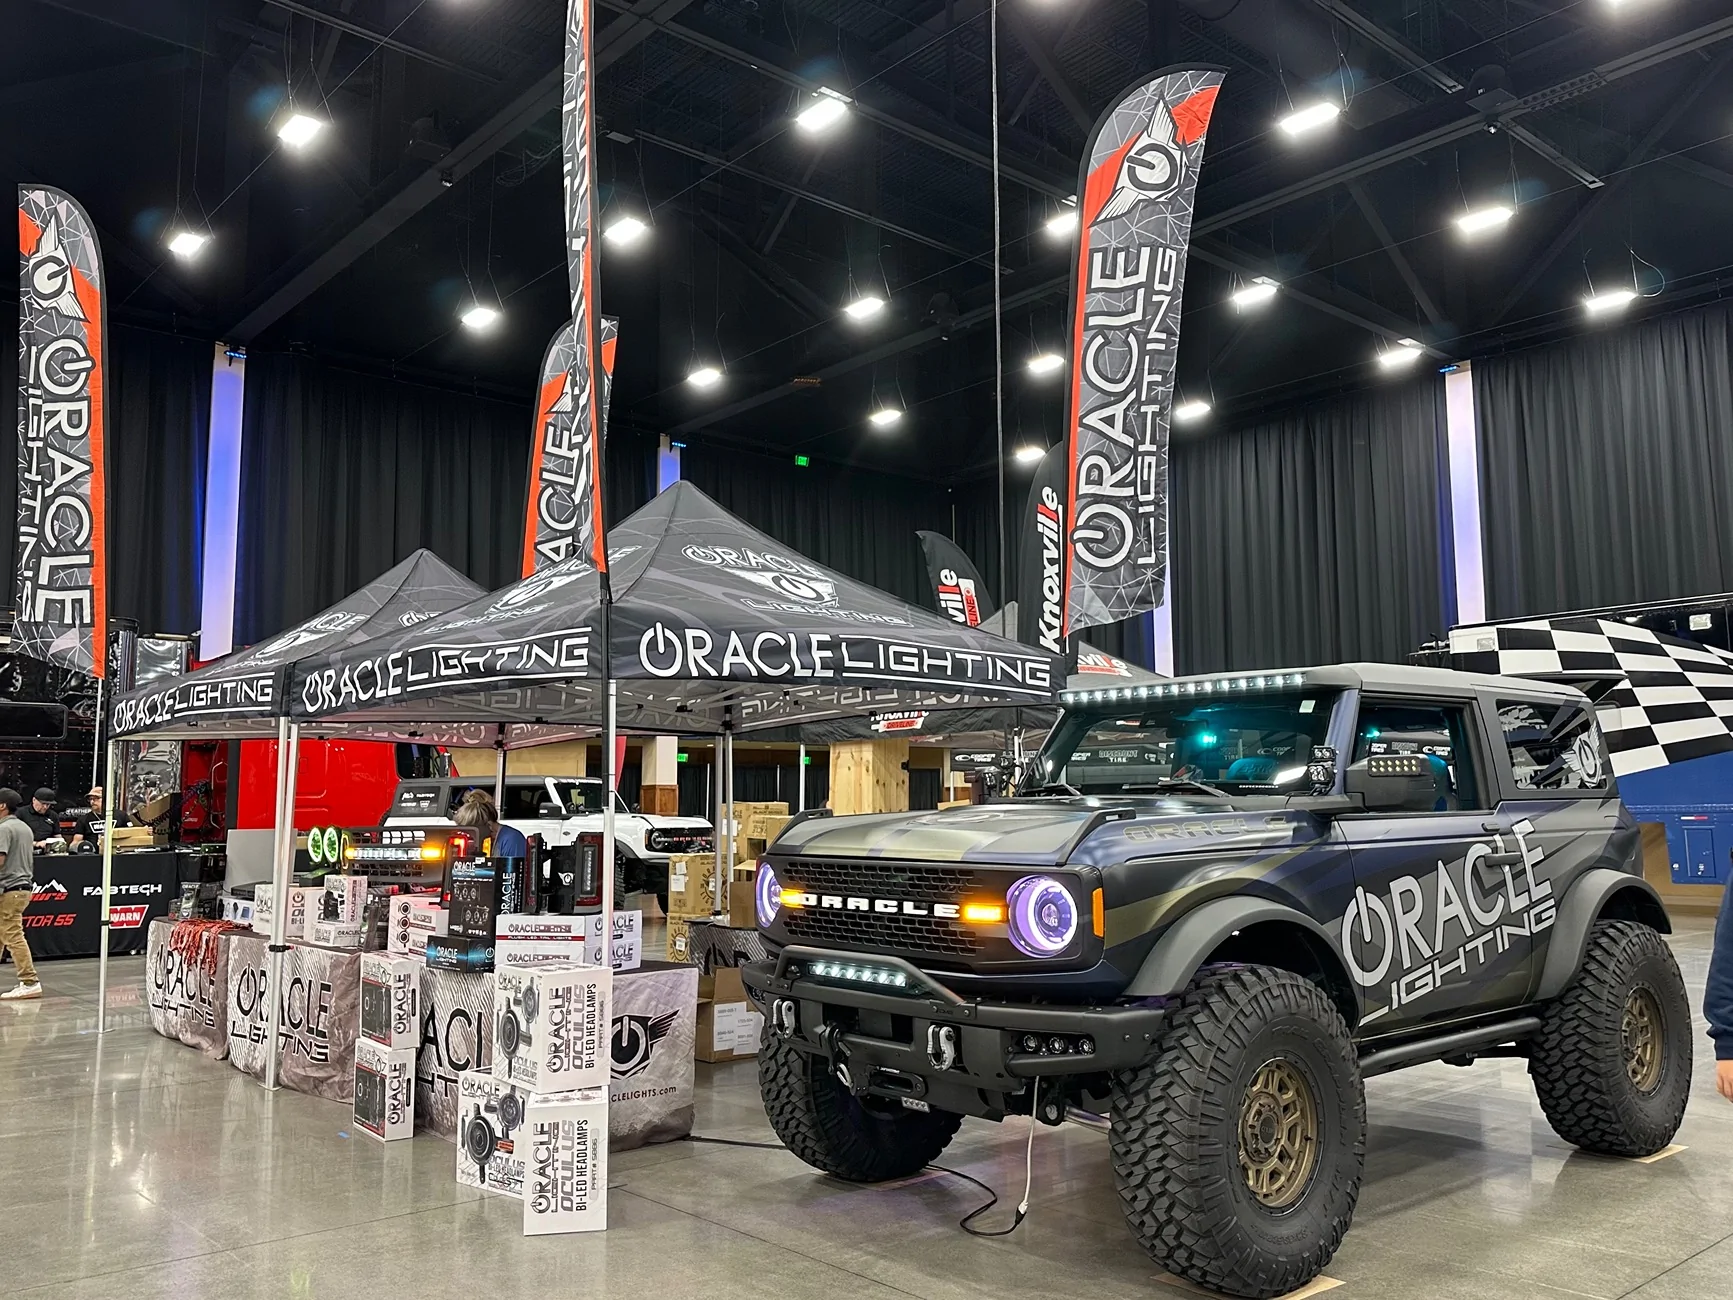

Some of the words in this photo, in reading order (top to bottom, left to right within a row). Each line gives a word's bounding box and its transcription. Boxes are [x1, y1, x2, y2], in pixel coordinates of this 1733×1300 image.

[1072, 247, 1150, 568] ORACLE
[1137, 247, 1176, 565] LIGHTING
[35, 338, 93, 624] ORACLE
[1037, 486, 1061, 653] Knoxville
[302, 651, 403, 713] ORACLE
[406, 636, 589, 684] LIGHTING
[640, 621, 834, 678] ORACLE
[841, 641, 1051, 688] LIGHTING
[113, 689, 177, 734] ORACLE
[173, 678, 274, 712] LIGHTING
[1122, 815, 1287, 843] ORACLE
[454, 861, 476, 871] ORACLE
[110, 911, 141, 923] WARN
[508, 924, 539, 933] ORACLE
[798, 893, 960, 918] ORACLE
[1341, 817, 1553, 987] ORACLE
[436, 947, 458, 959] ORACLE
[393, 974, 407, 1034] ORACLE
[546, 987, 566, 1073] ORACLE
[564, 986, 572, 1072] LIGHTING
[572, 984, 586, 1070] OCULUS
[586, 983, 597, 1037] HEADLAMPS
[585, 1035, 595, 1069] BI-LED
[388, 1063, 402, 1125] ORACLE
[462, 1076, 500, 1097] ORACLE
[530, 1122, 552, 1214] ORACLE
[551, 1121, 560, 1213] LIGHTING
[560, 1119, 575, 1212] OCULUS
[576, 1119, 588, 1177] HEADLAMPS
[576, 1179, 587, 1211] BI-LED
